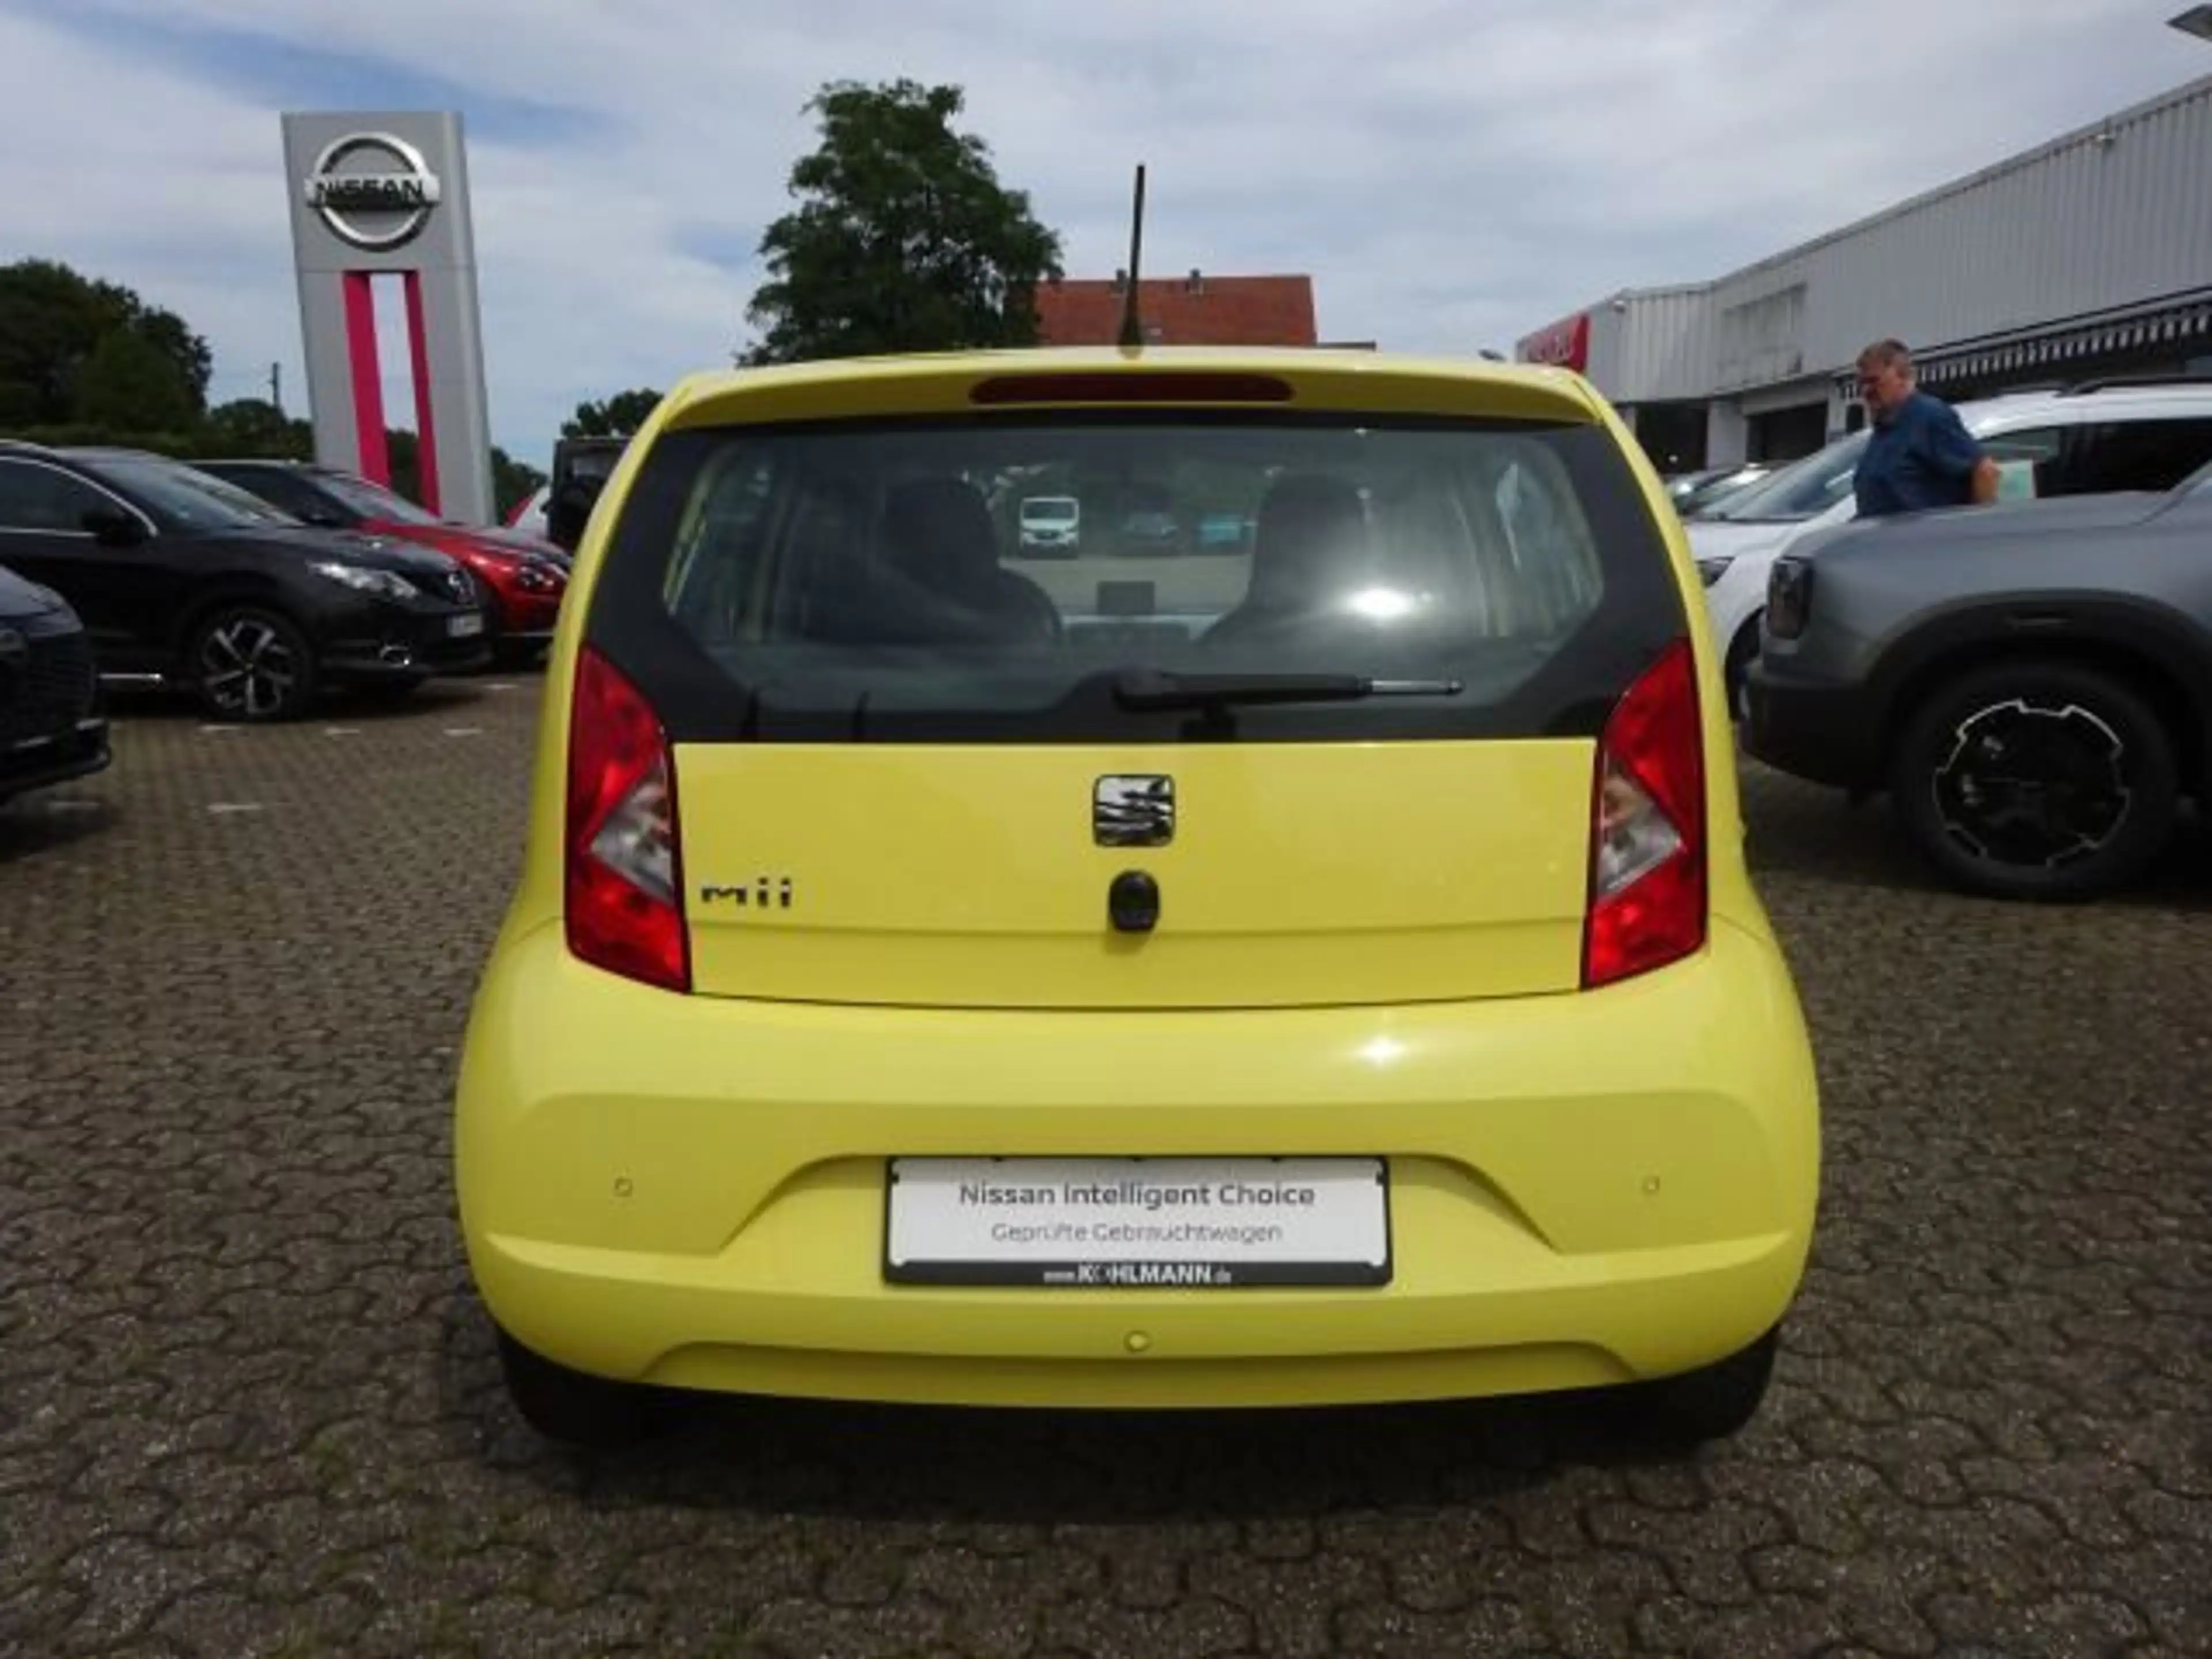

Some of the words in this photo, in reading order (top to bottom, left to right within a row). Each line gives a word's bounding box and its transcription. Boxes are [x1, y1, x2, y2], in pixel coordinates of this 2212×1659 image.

[960, 1184, 1055, 1205] Nissan
[1064, 1183, 1210, 1210] Intelligent
[1219, 1184, 1315, 1205] Choice
[1092, 1222, 1283, 1247] Gebrauchtwagen
